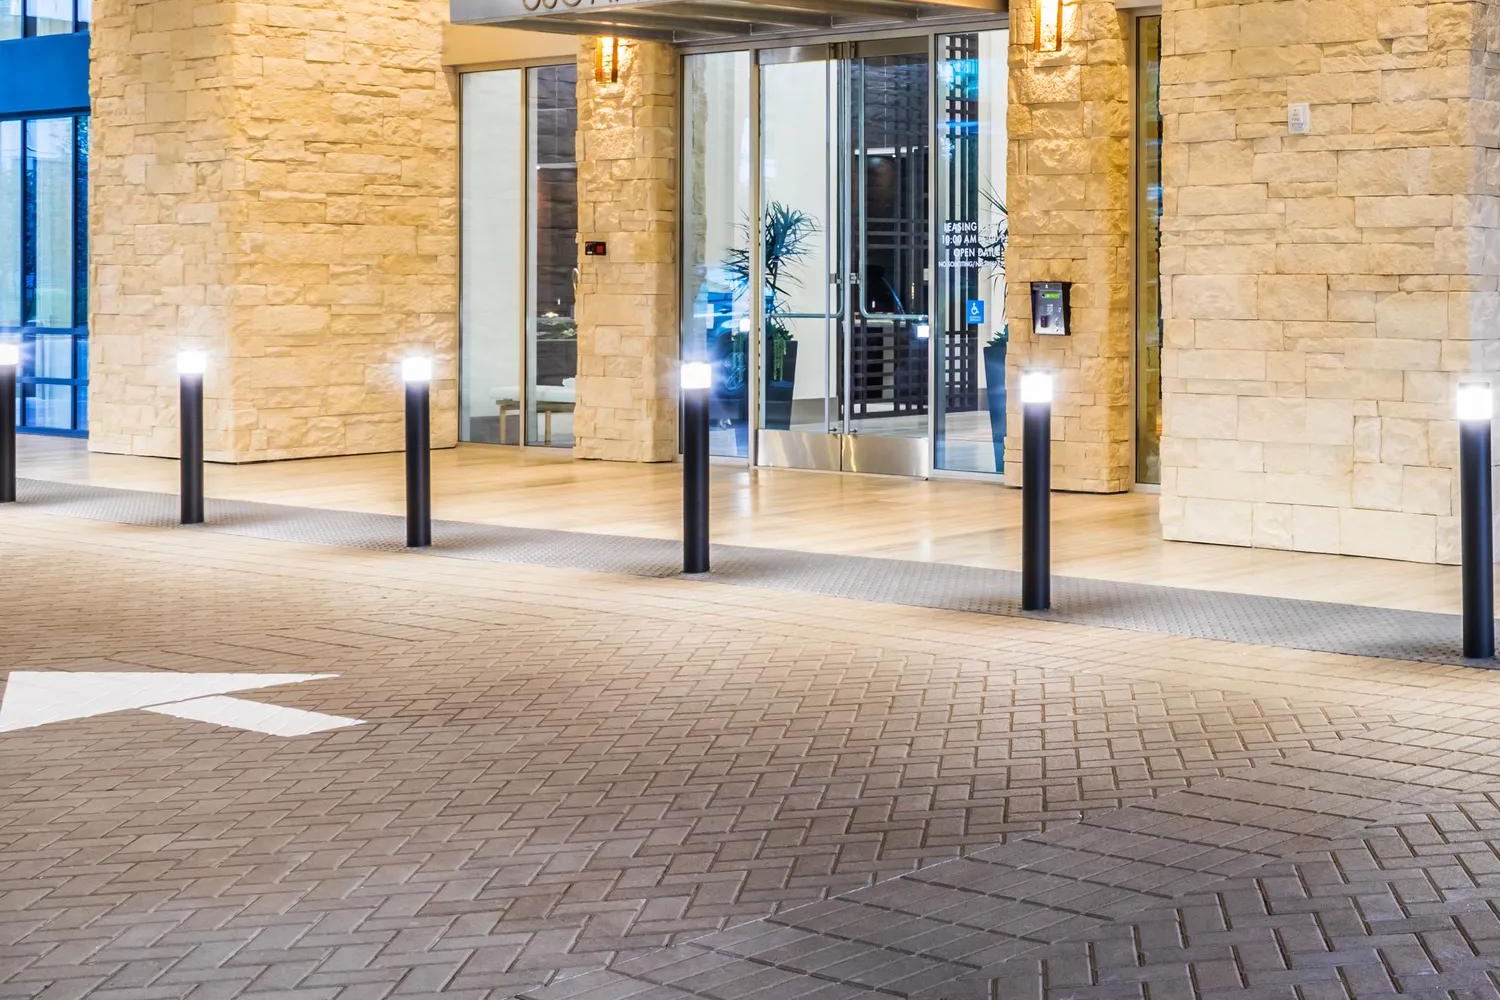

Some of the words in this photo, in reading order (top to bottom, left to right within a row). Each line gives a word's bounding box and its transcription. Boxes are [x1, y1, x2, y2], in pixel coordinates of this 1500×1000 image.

[943, 221, 978, 232] LEASING
[941, 234, 962, 245] 10:00
[963, 234, 977, 244] AM
[953, 247, 976, 257] OPEN
